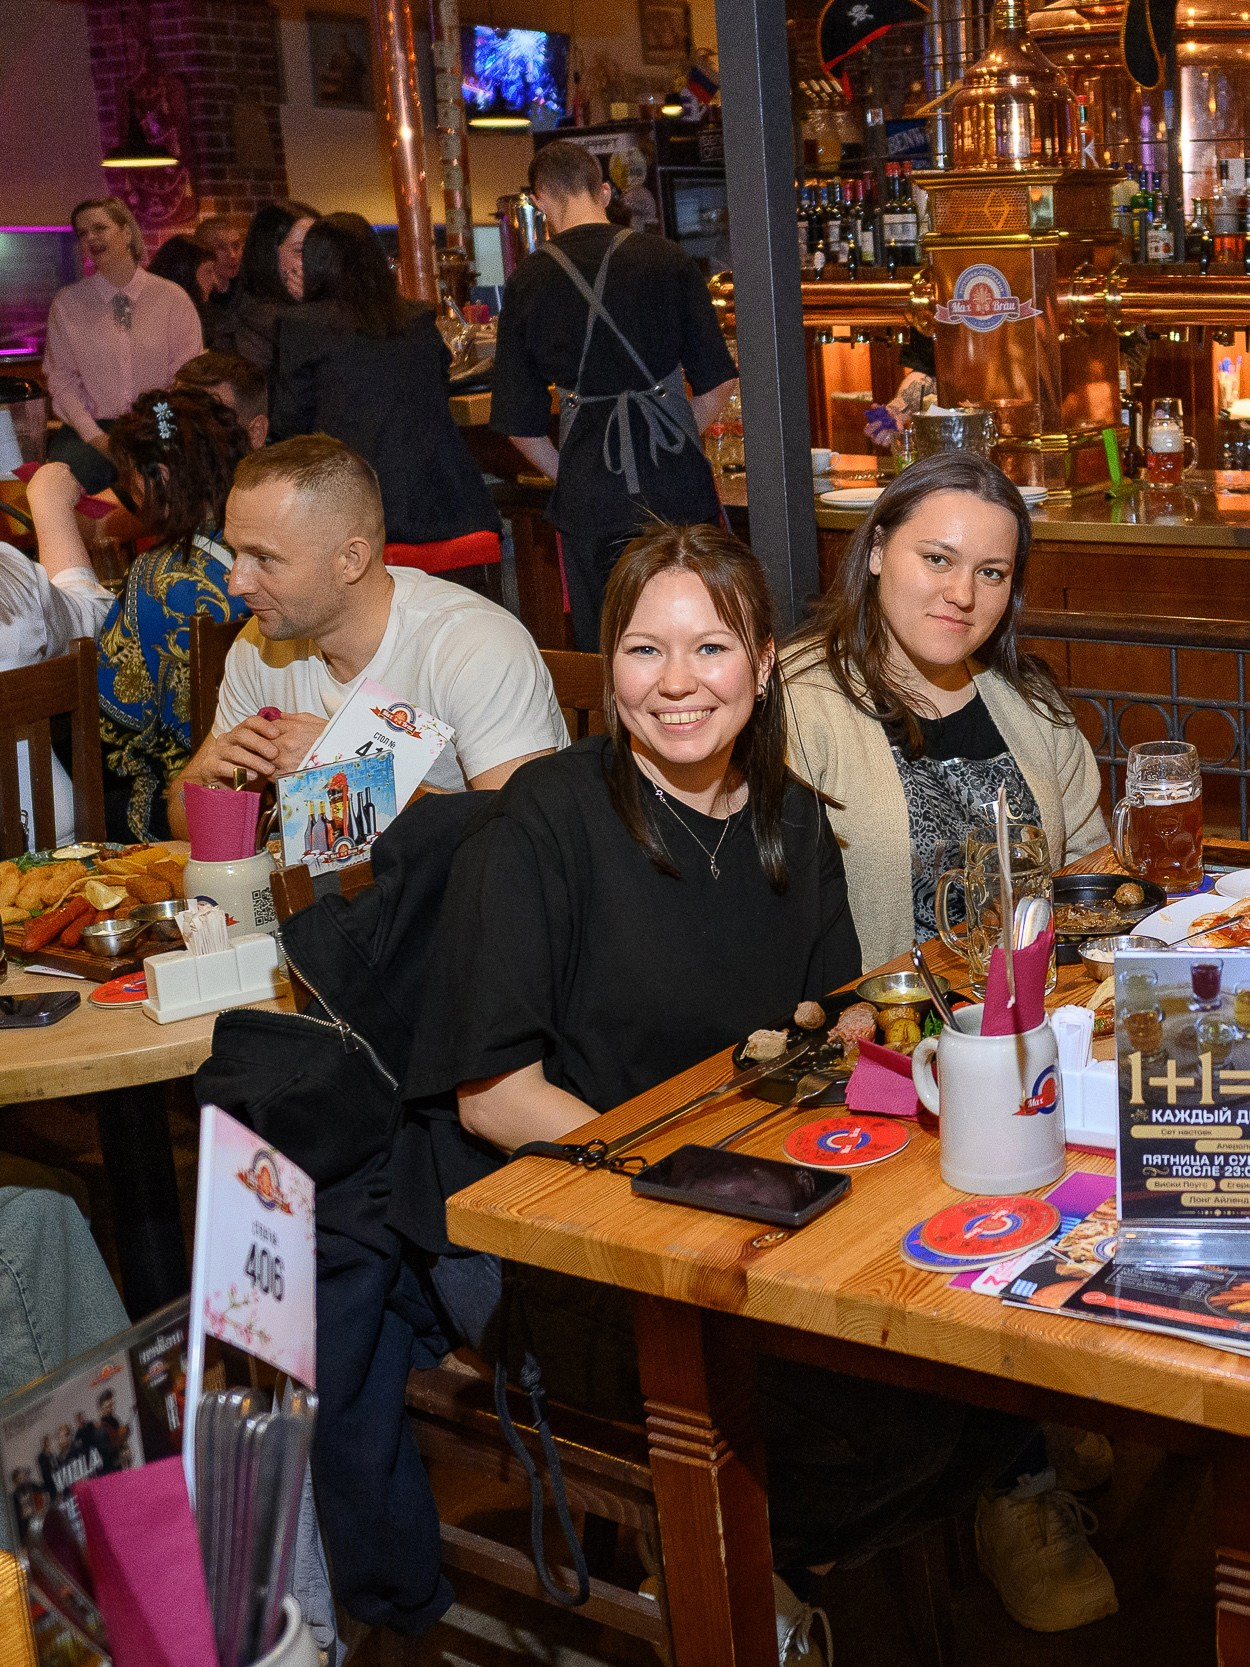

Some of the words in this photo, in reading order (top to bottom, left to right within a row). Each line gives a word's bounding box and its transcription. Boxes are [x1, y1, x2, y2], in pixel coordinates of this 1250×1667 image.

[951, 301, 971, 313] Max
[373, 731, 390, 745] СТОЛ
[1027, 1097, 1044, 1108] Max
[1151, 1107, 1232, 1124] КАЖДЫЙ
[1161, 1128, 1177, 1136] Сет
[1142, 1154, 1210, 1167] ПЯТНИЦА
[1213, 1154, 1225, 1166] И
[1172, 1166, 1220, 1177] ПОСЛЕ
[1154, 1181, 1182, 1189] Виски
[1189, 1196, 1211, 1205] Лонг
[1213, 1195, 1250, 1206] Айленд
[243, 1242, 286, 1302] 406
